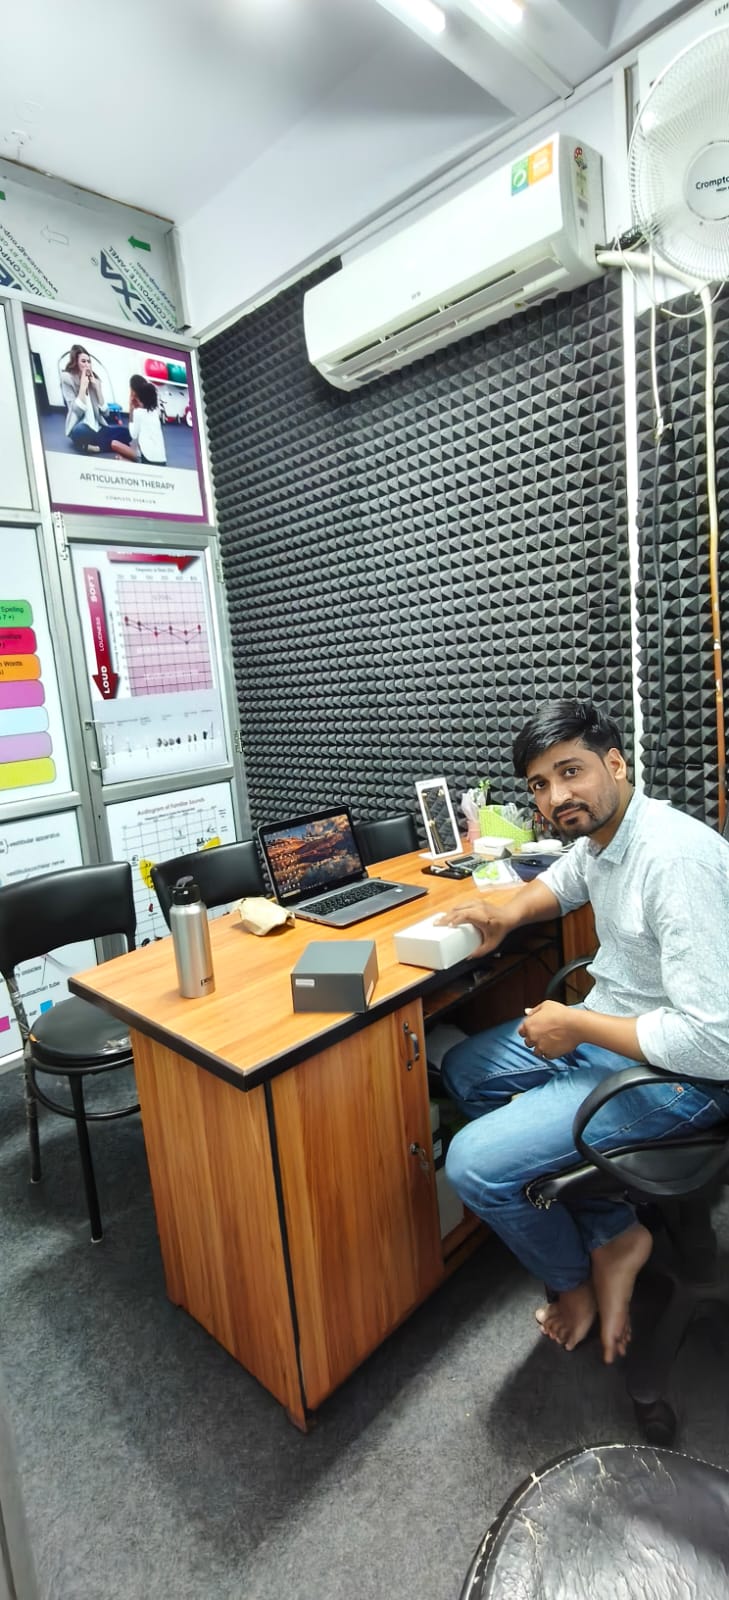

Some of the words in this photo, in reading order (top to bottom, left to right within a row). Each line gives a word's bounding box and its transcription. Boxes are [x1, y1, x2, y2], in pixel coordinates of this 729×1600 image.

[108, 245, 129, 273] PANEL
[100, 249, 163, 329] EXA
[128, 271, 167, 319] COMPOSITE
[79, 472, 140, 487] ARTICULATION
[140, 479, 176, 491] THERAPY
[88, 574, 98, 603] SOFT
[100, 665, 111, 694] LOUD
